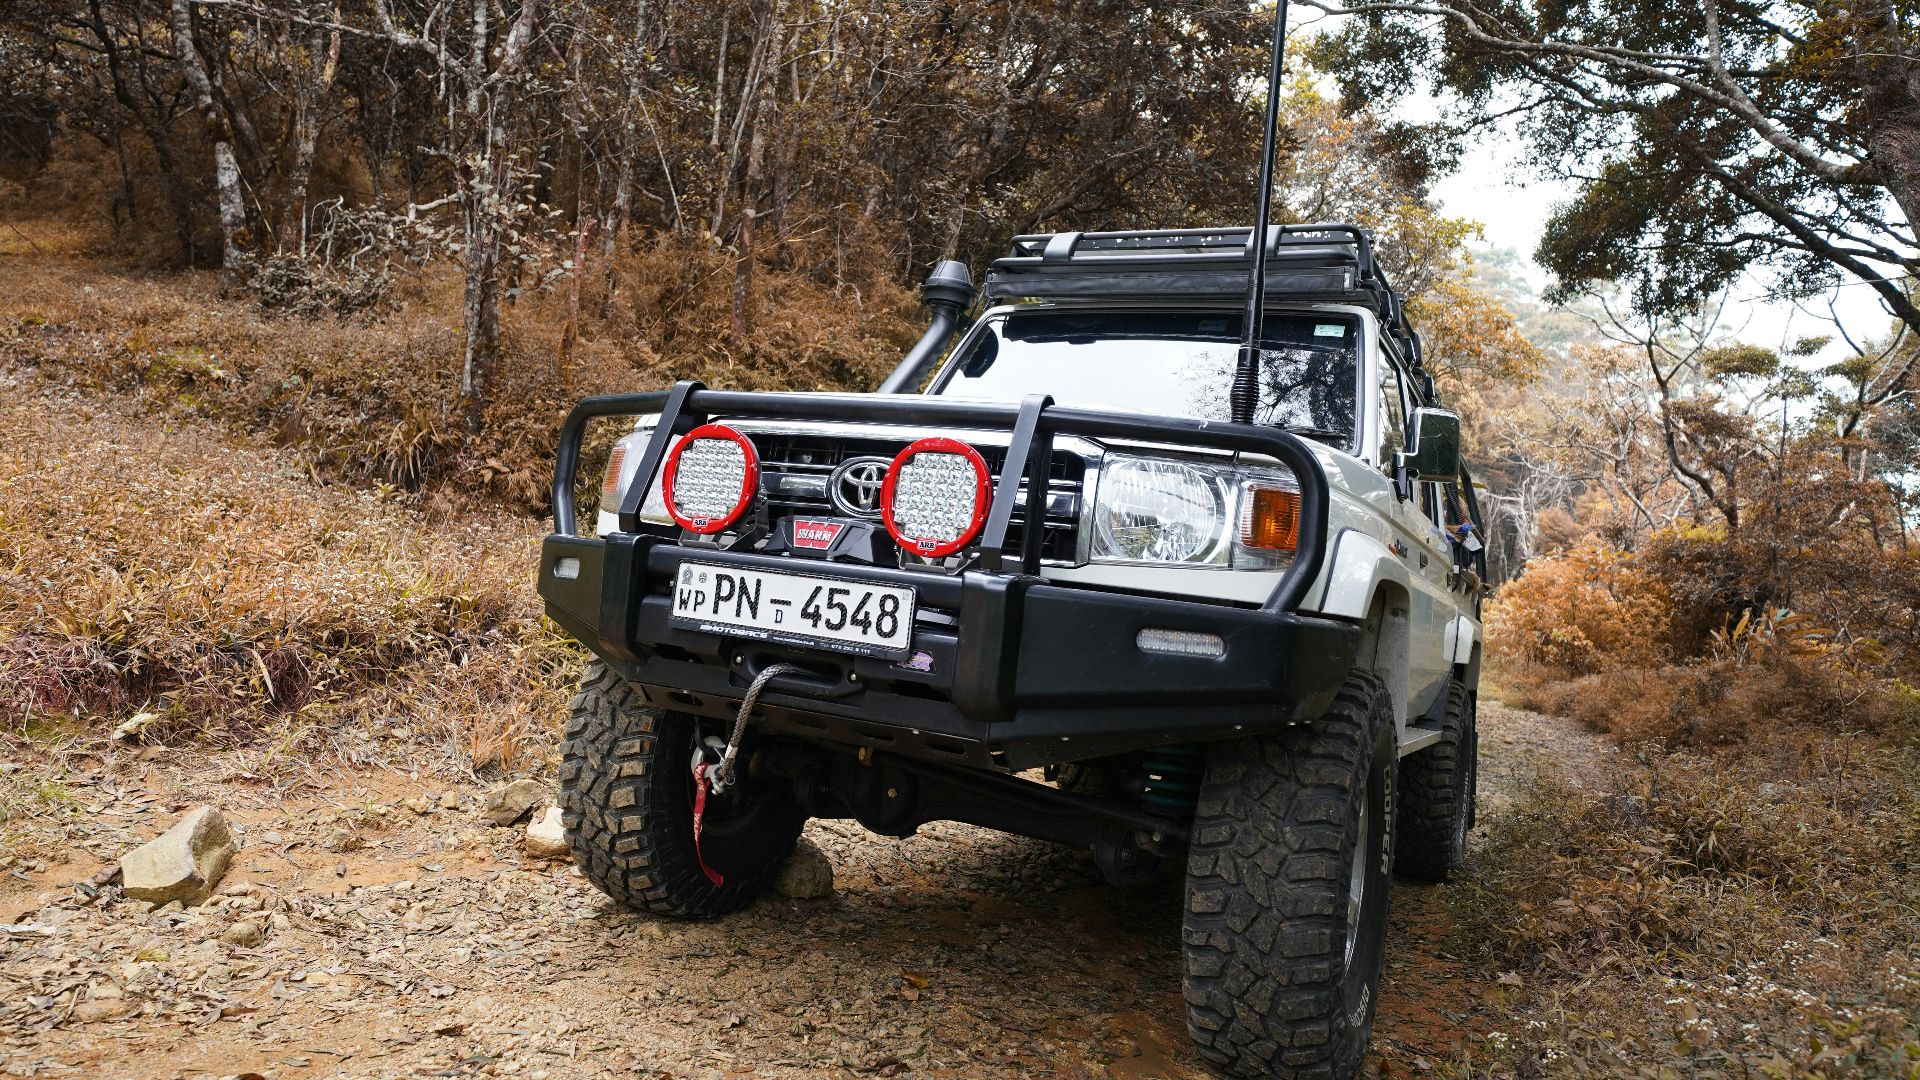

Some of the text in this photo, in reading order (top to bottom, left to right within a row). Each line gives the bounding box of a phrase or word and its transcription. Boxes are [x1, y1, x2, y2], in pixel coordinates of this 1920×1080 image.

[797, 529, 833, 542] WARN
[919, 541, 935, 549] ARB
[678, 588, 706, 612] WP
[774, 609, 783, 624] D
[1380, 764, 1392, 875] COOPER
